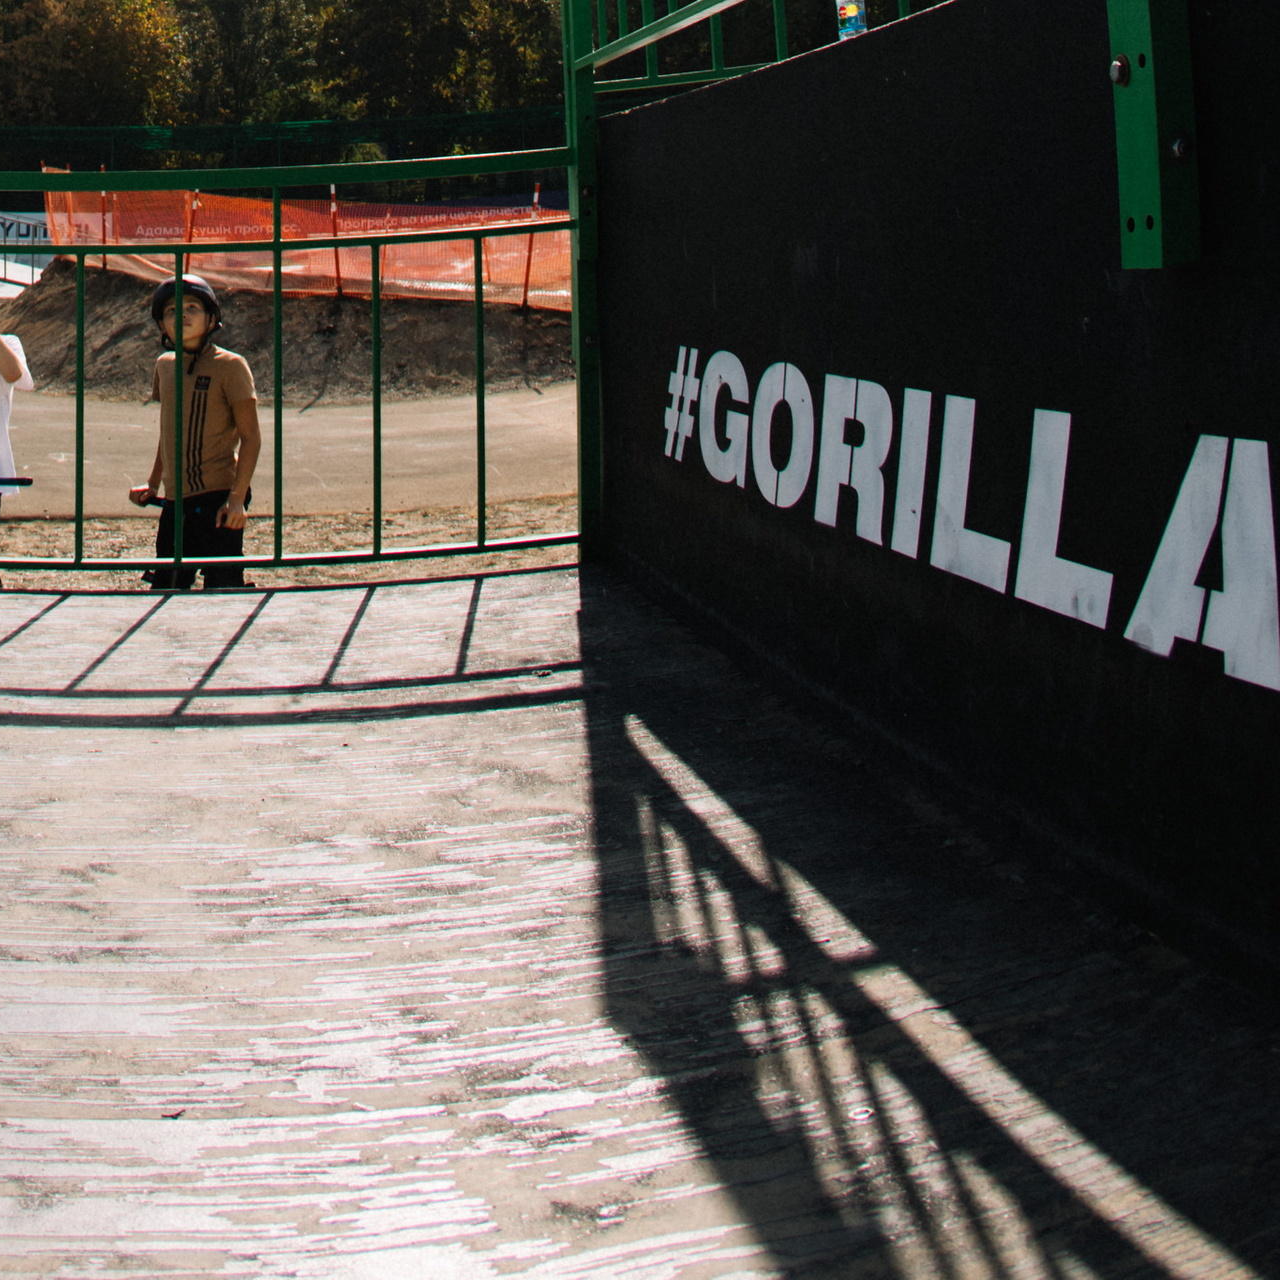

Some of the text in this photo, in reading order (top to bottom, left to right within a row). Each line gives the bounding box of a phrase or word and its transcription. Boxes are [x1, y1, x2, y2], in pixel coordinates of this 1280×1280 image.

[135, 224, 186, 237] Адамза
[234, 223, 301, 236] прогрсс.
[664, 345, 1280, 692] #GORILLA
